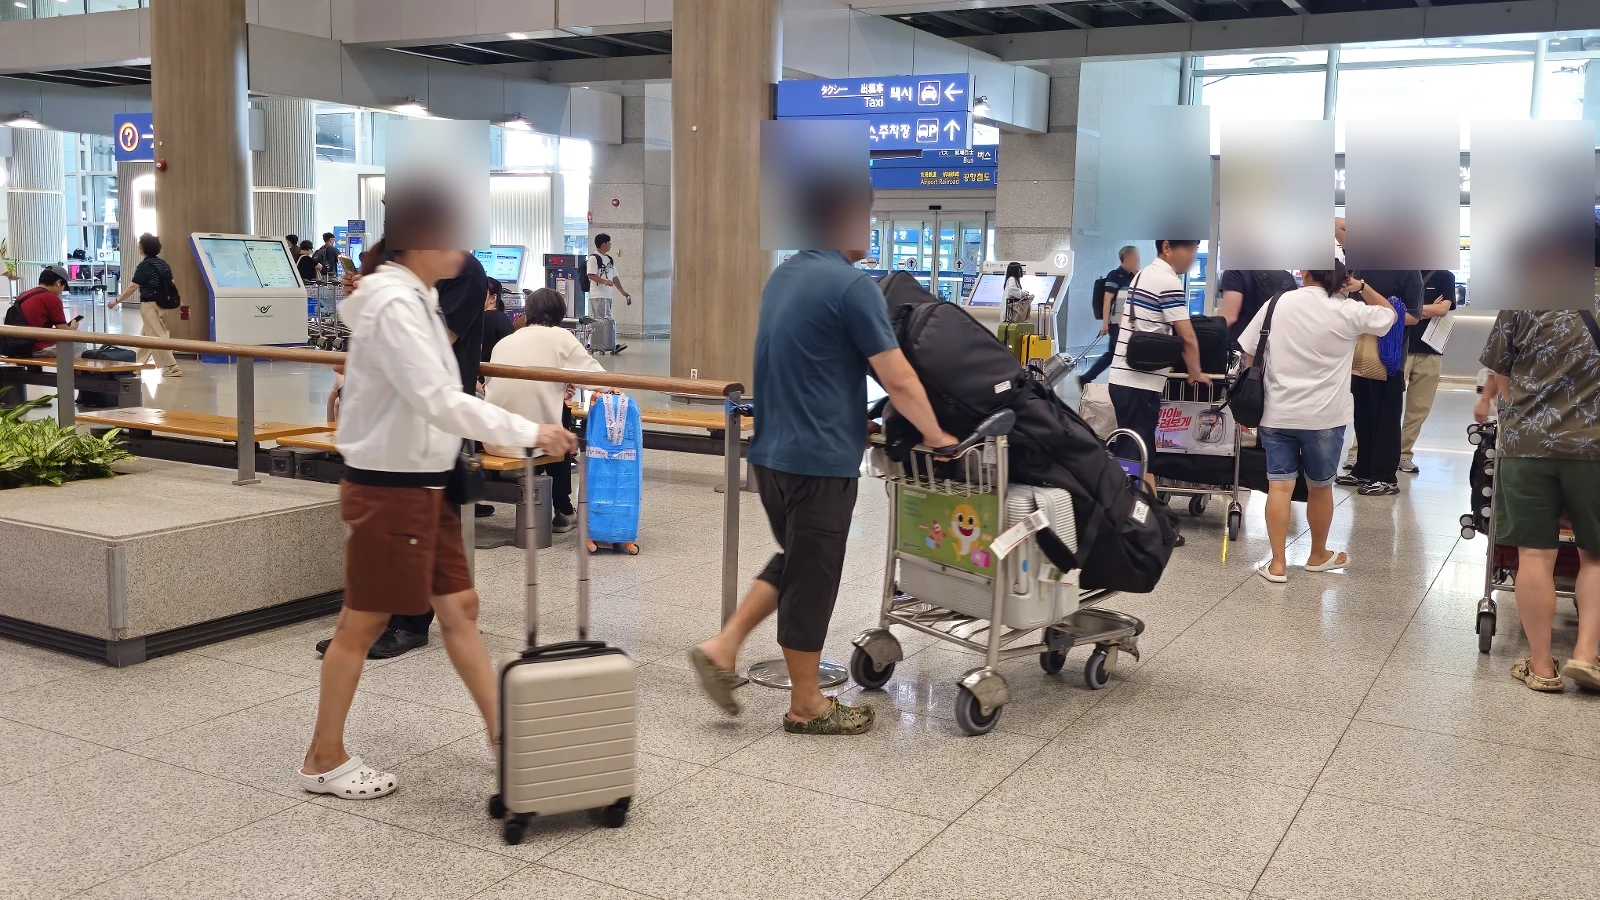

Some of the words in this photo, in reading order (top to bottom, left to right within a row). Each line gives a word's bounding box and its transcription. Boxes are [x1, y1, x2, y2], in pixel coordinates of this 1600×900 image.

[821, 84, 848, 95] タクシー
[890, 87, 912, 101] 택시
[864, 96, 884, 108] Taxi
[963, 156, 974, 164] Bus
[977, 151, 992, 161] 버스
[963, 172, 990, 183] 공항철도
[1157, 416, 1192, 428] 려보게
